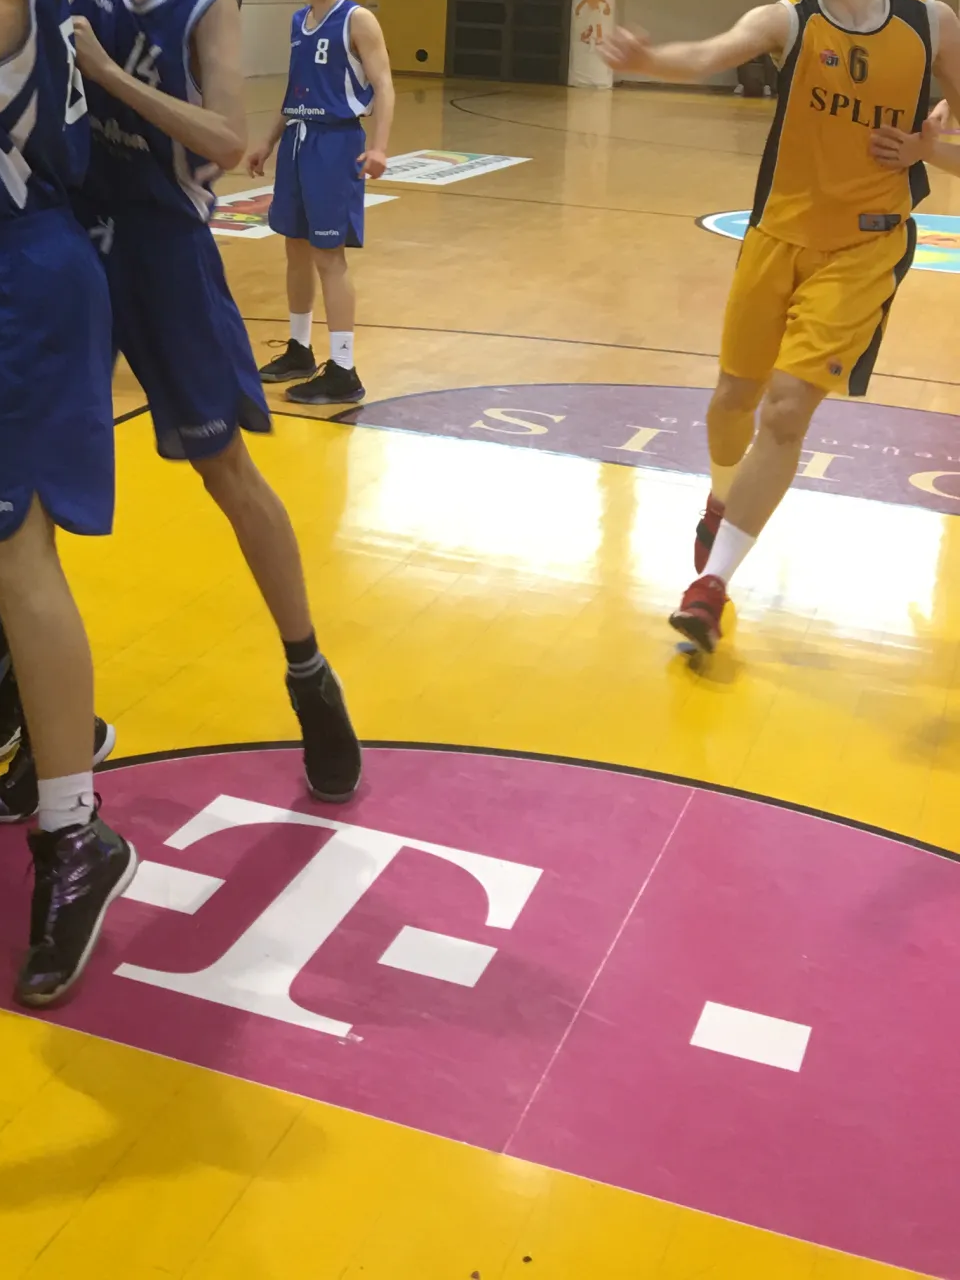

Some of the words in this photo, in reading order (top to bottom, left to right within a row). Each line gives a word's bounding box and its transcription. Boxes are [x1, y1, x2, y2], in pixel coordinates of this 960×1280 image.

[314, 38, 329, 65] 8
[847, 45, 870, 85] 6
[809, 86, 905, 129] SPLIT
